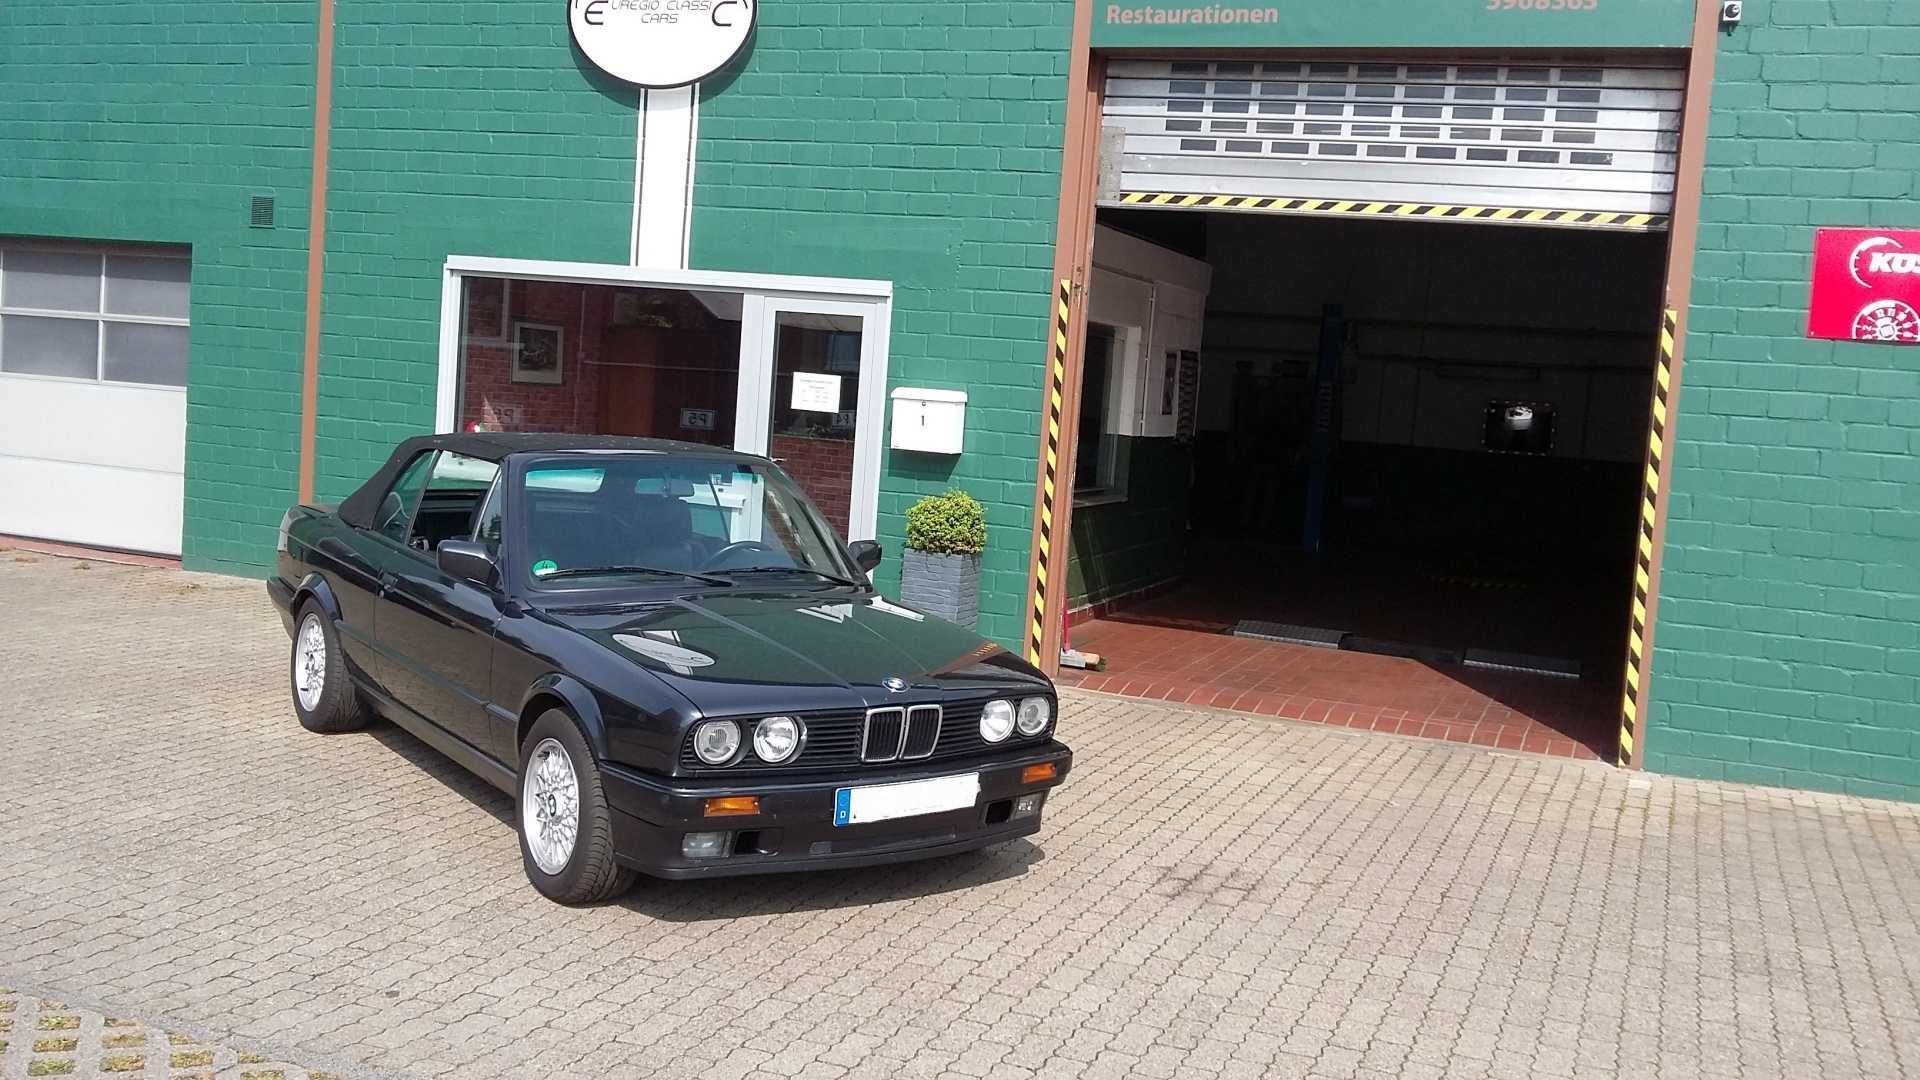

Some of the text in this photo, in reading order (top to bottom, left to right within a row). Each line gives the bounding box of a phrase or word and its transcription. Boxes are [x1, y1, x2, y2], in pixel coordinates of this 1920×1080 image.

[641, 12, 679, 24] CARS
[1106, 5, 1279, 24] Restaurationen
[840, 810, 846, 819] D
